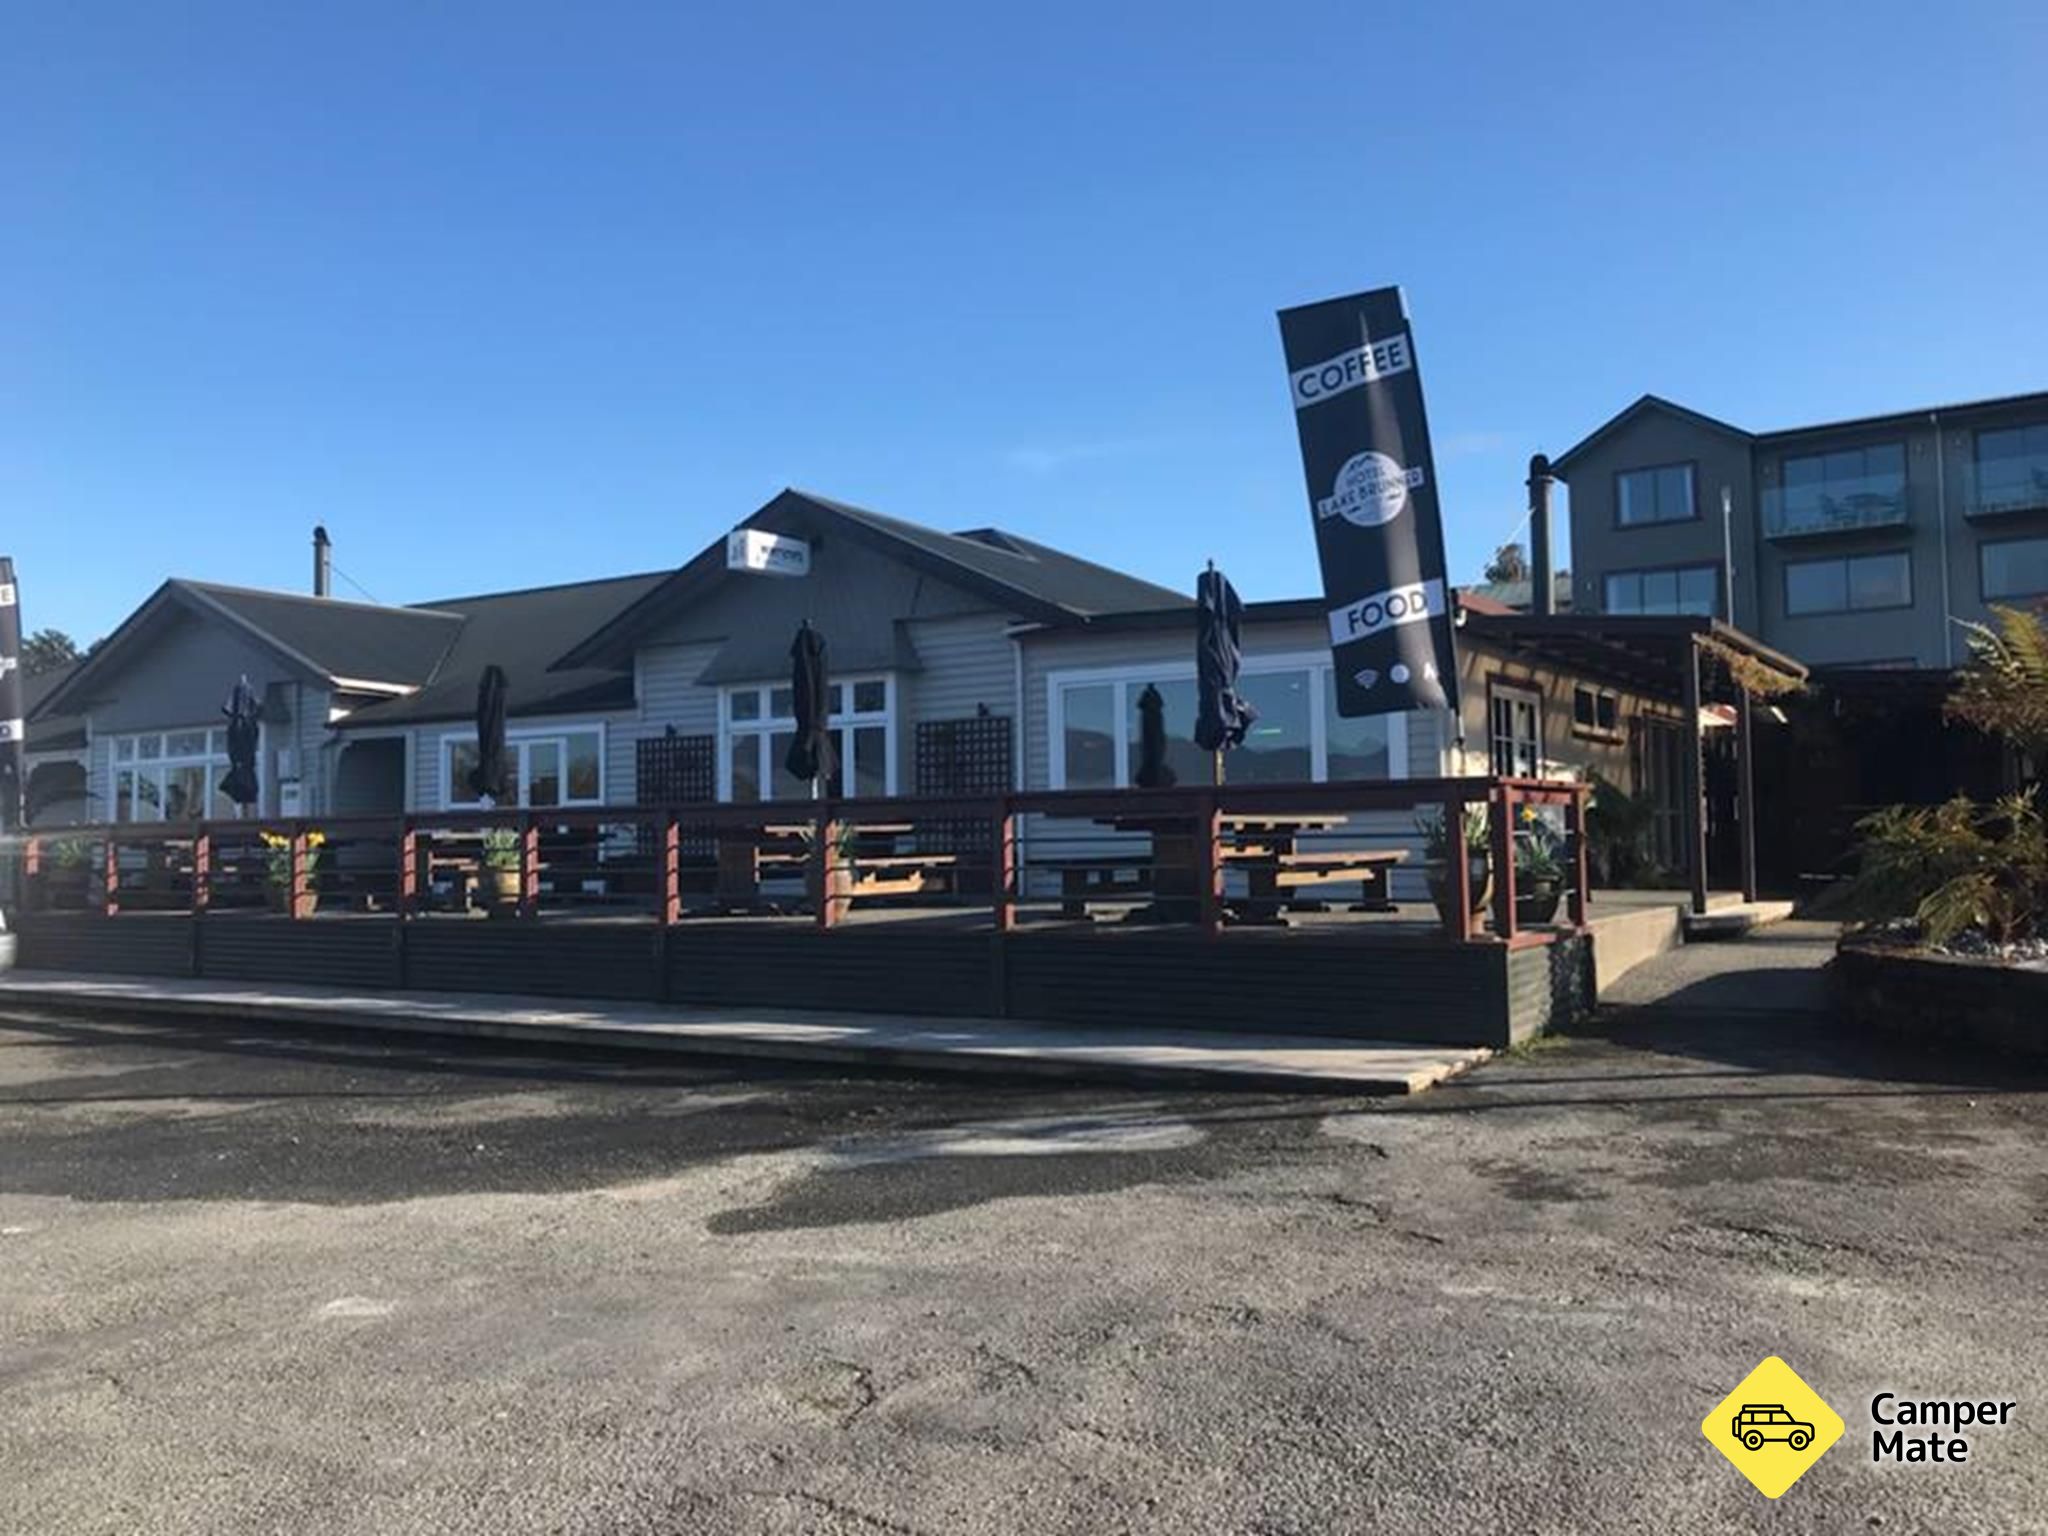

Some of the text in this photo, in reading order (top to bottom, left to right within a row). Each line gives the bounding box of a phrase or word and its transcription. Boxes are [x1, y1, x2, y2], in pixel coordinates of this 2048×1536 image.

[1298, 342, 1404, 398] COFFEE
[1346, 466, 1386, 486] HOTEL
[1321, 488, 1357, 516] LAKE
[1348, 590, 1428, 634] FOOD
